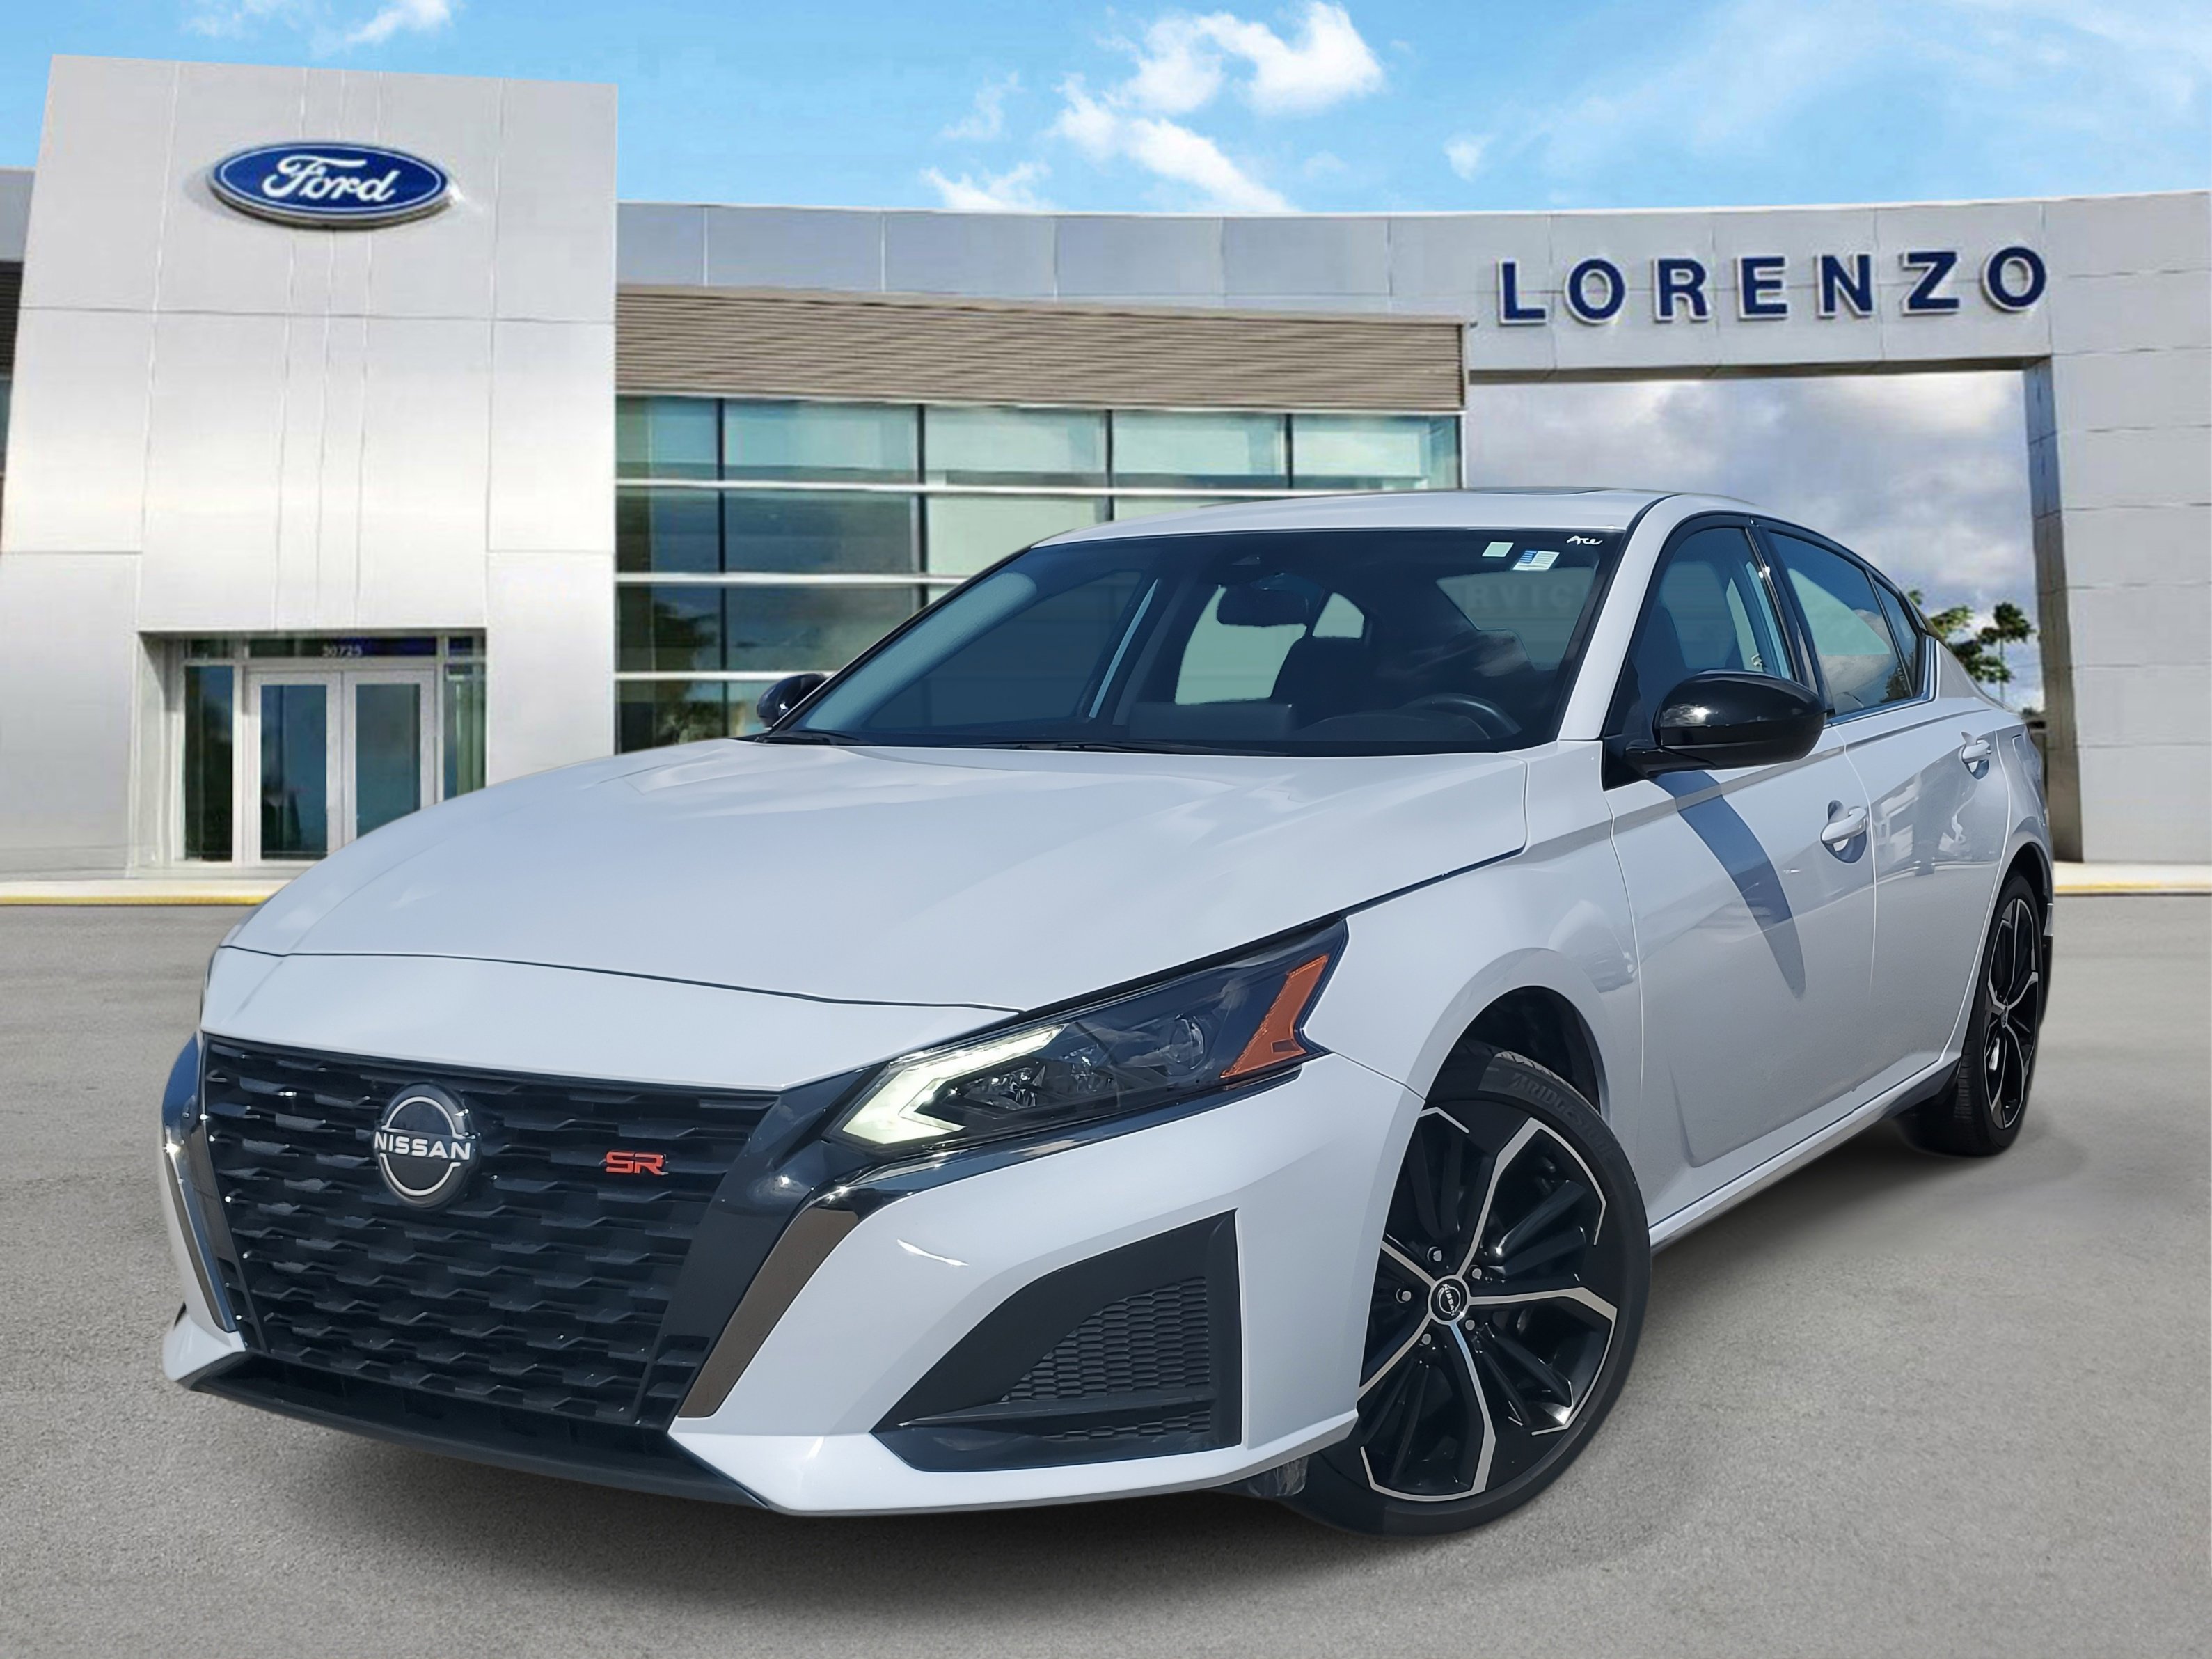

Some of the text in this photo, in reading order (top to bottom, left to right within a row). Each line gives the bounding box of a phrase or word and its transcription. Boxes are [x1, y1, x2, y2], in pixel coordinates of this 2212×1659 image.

[262, 156, 400, 202] Ford
[1499, 245, 2047, 325] LORENZO
[374, 1130, 471, 1161] NISSAN
[604, 1151, 668, 1176] SR
[1442, 1283, 1456, 1316] NISSAN
